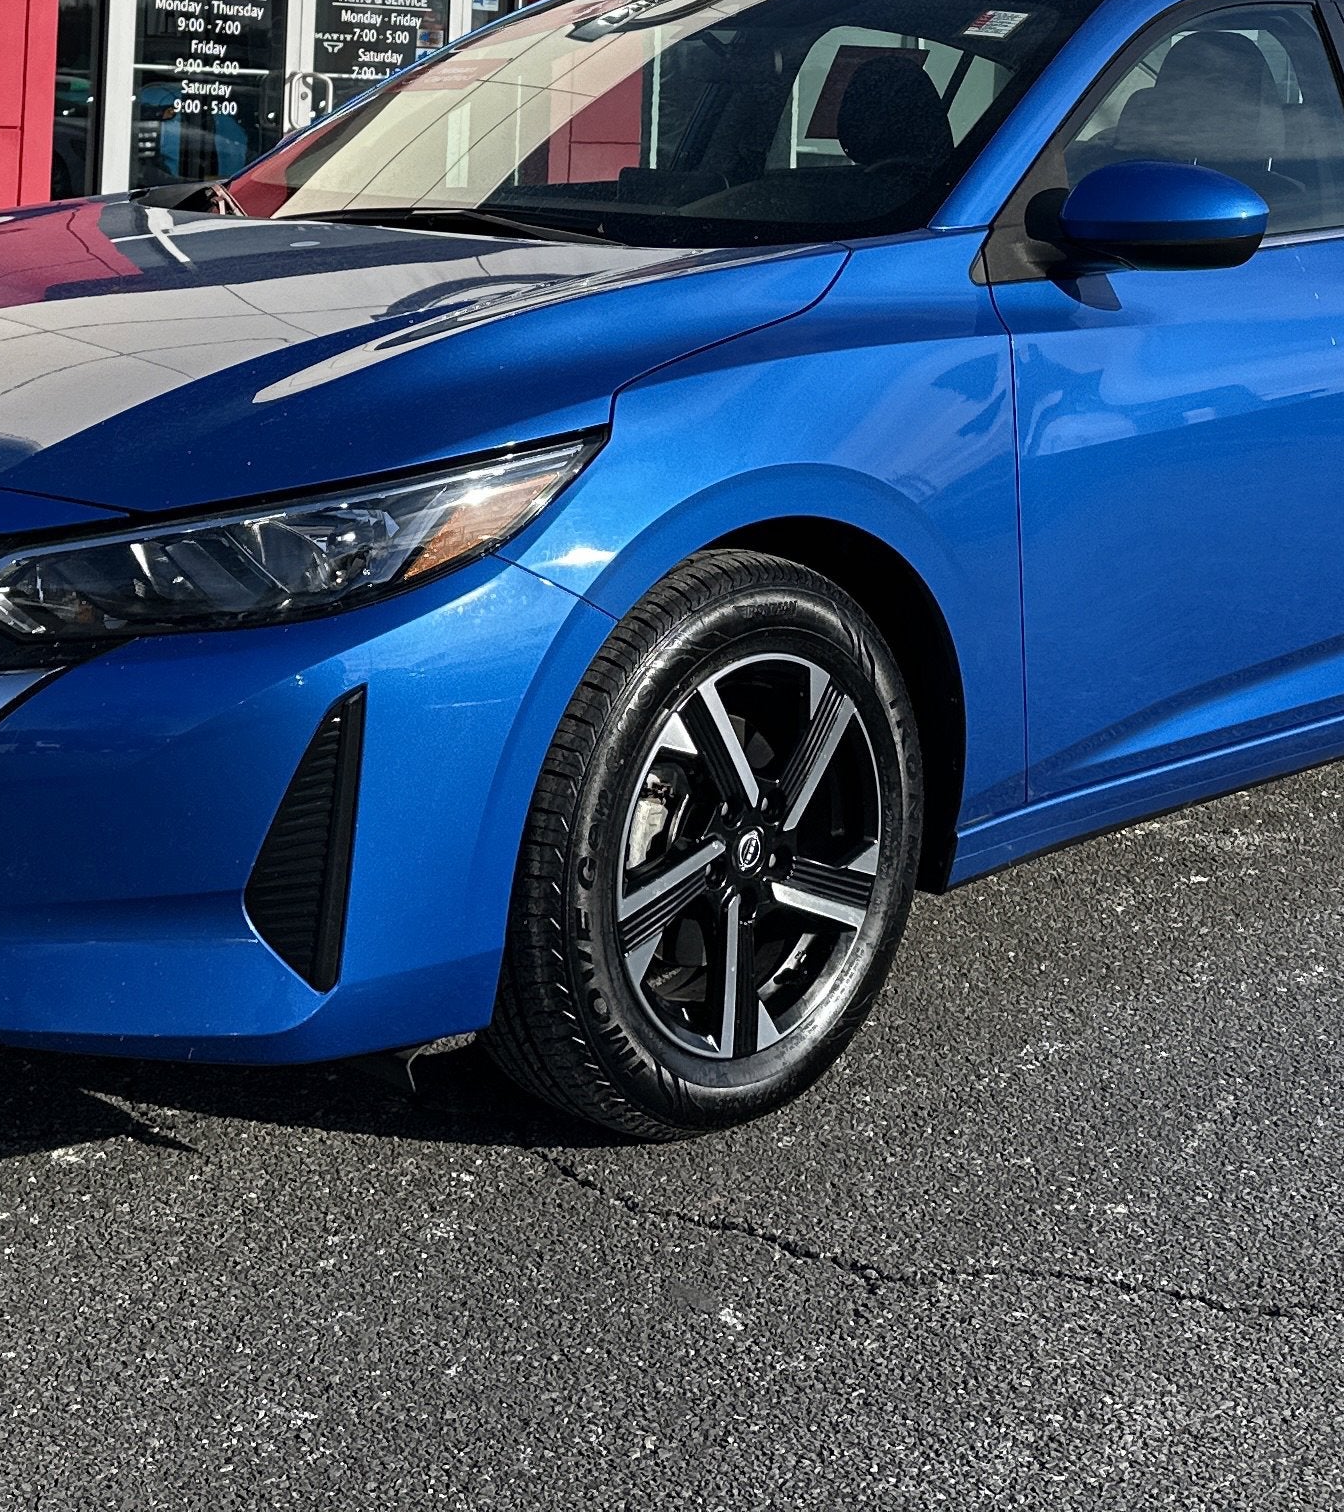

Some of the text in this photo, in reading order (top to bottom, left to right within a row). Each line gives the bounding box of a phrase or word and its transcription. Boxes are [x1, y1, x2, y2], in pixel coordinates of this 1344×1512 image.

[211, 0, 265, 20] Thursday
[341, 9, 383, 27] Monday
[390, 12, 422, 29] Friday
[177, 16, 205, 32] 9:00
[215, 19, 241, 35] 7:00
[353, 28, 377, 42] 7:00
[385, 30, 410, 44] 5:00
[190, 40, 227, 58] Friday
[357, 48, 404, 65] Saturday
[175, 57, 203, 73] 9:00
[212, 60, 239, 75] 6:00
[351, 66, 376, 80] 7:00
[181, 79, 232, 98] Saturday
[173, 98, 201, 113] 9:00
[210, 100, 237, 115] 5:00
